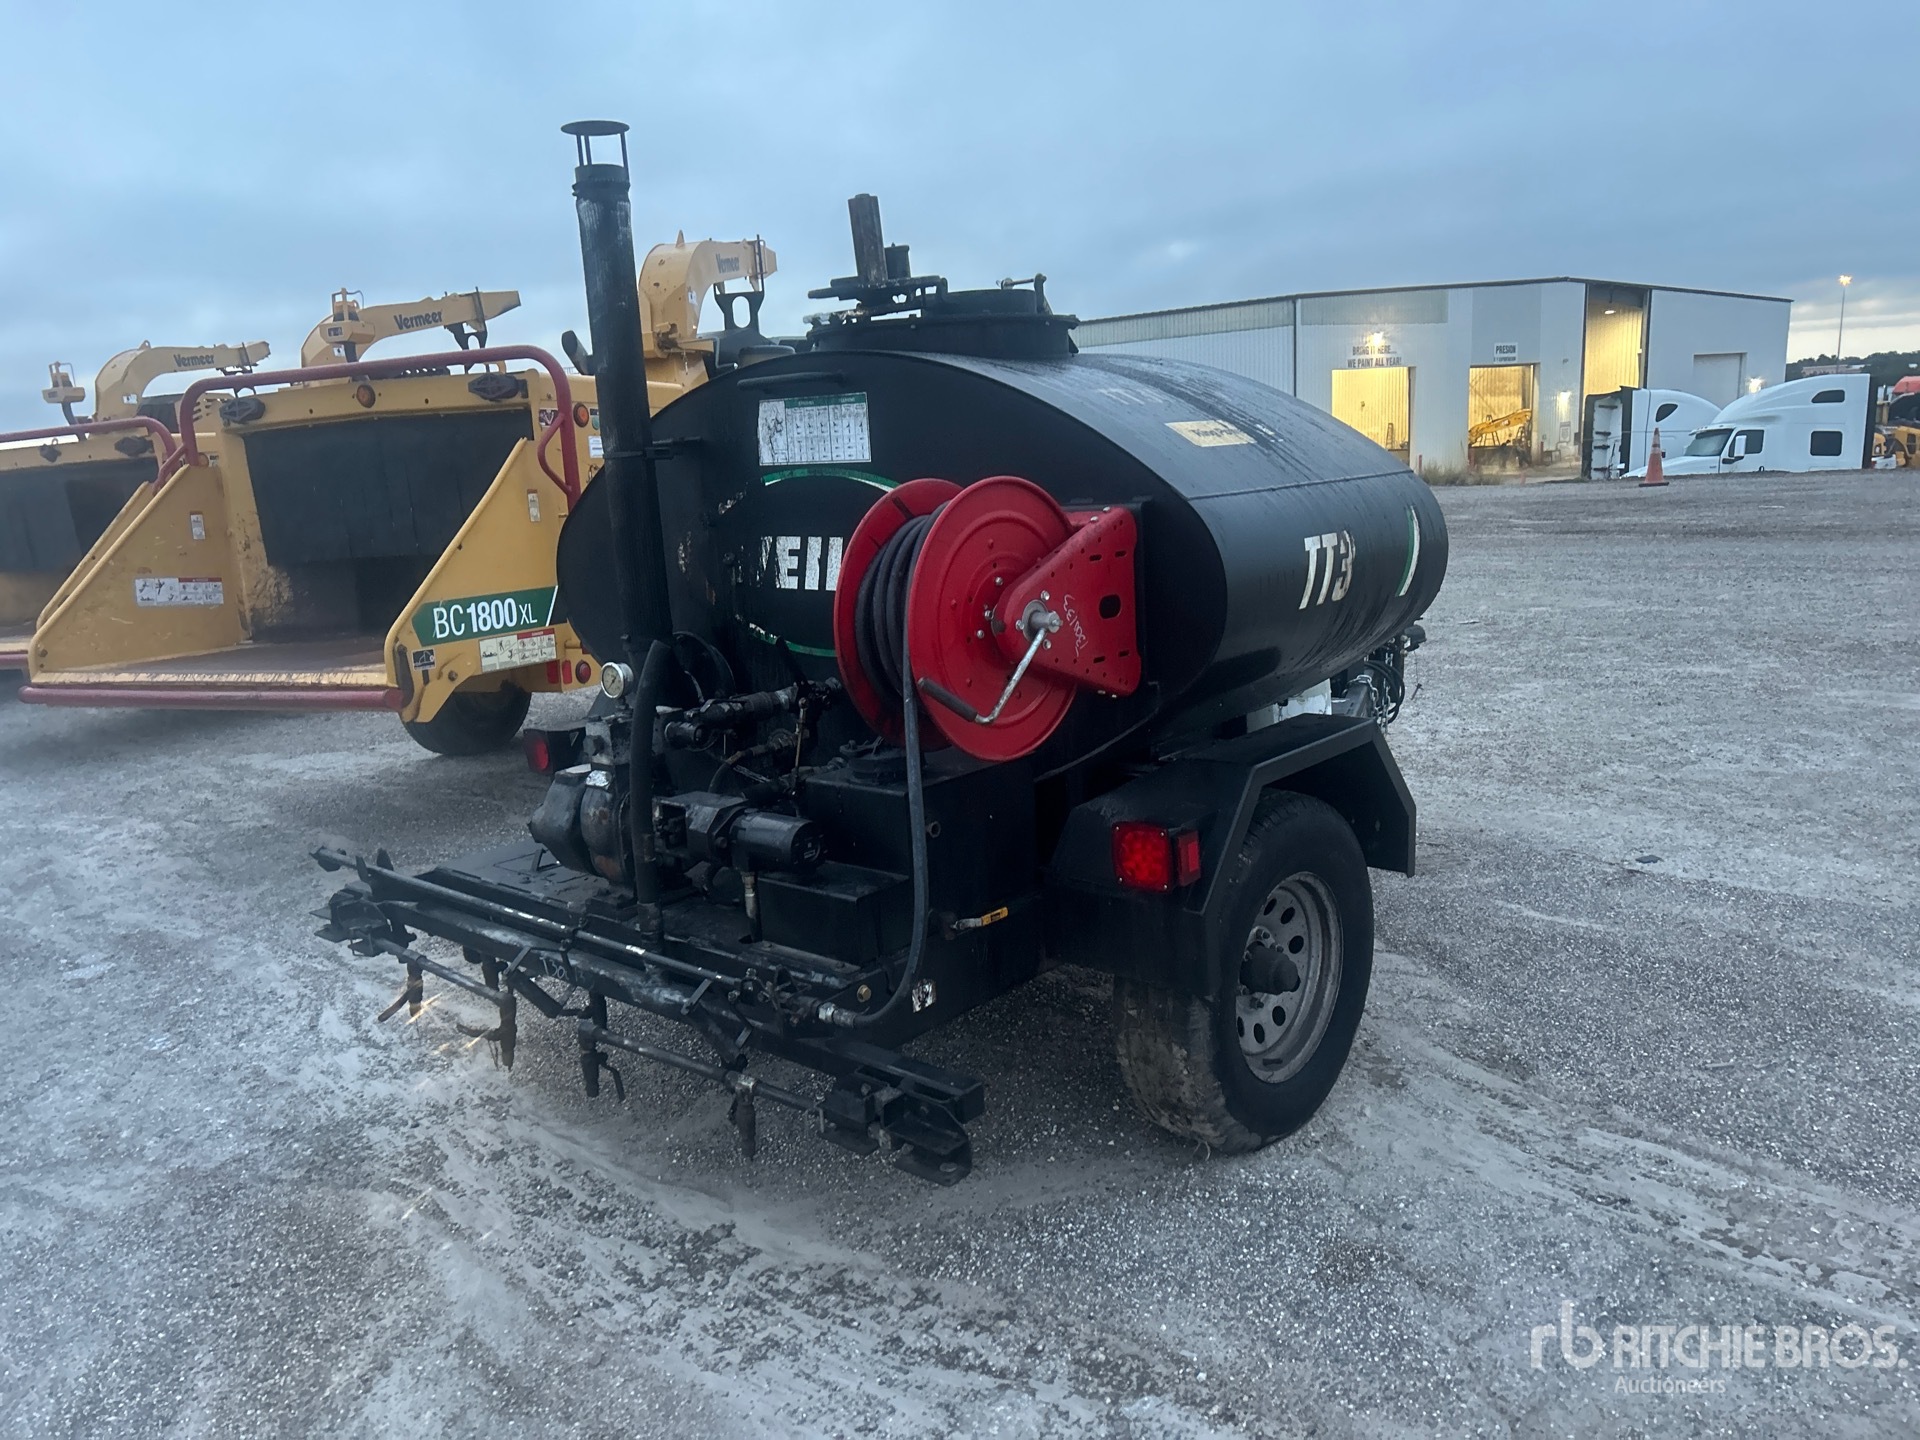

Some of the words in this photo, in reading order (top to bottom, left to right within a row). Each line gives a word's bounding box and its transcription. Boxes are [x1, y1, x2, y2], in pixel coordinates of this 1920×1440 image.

[393, 311, 443, 330] Vermeer
[173, 354, 215, 368] Vermeer
[1347, 359, 1356, 368] WE
[1357, 358, 1373, 368] PAINT
[1375, 357, 1384, 367] ALL
[1299, 530, 1356, 609] TT3
[433, 604, 465, 639] BC
[466, 598, 518, 633] 1800
[518, 603, 537, 625] XL
